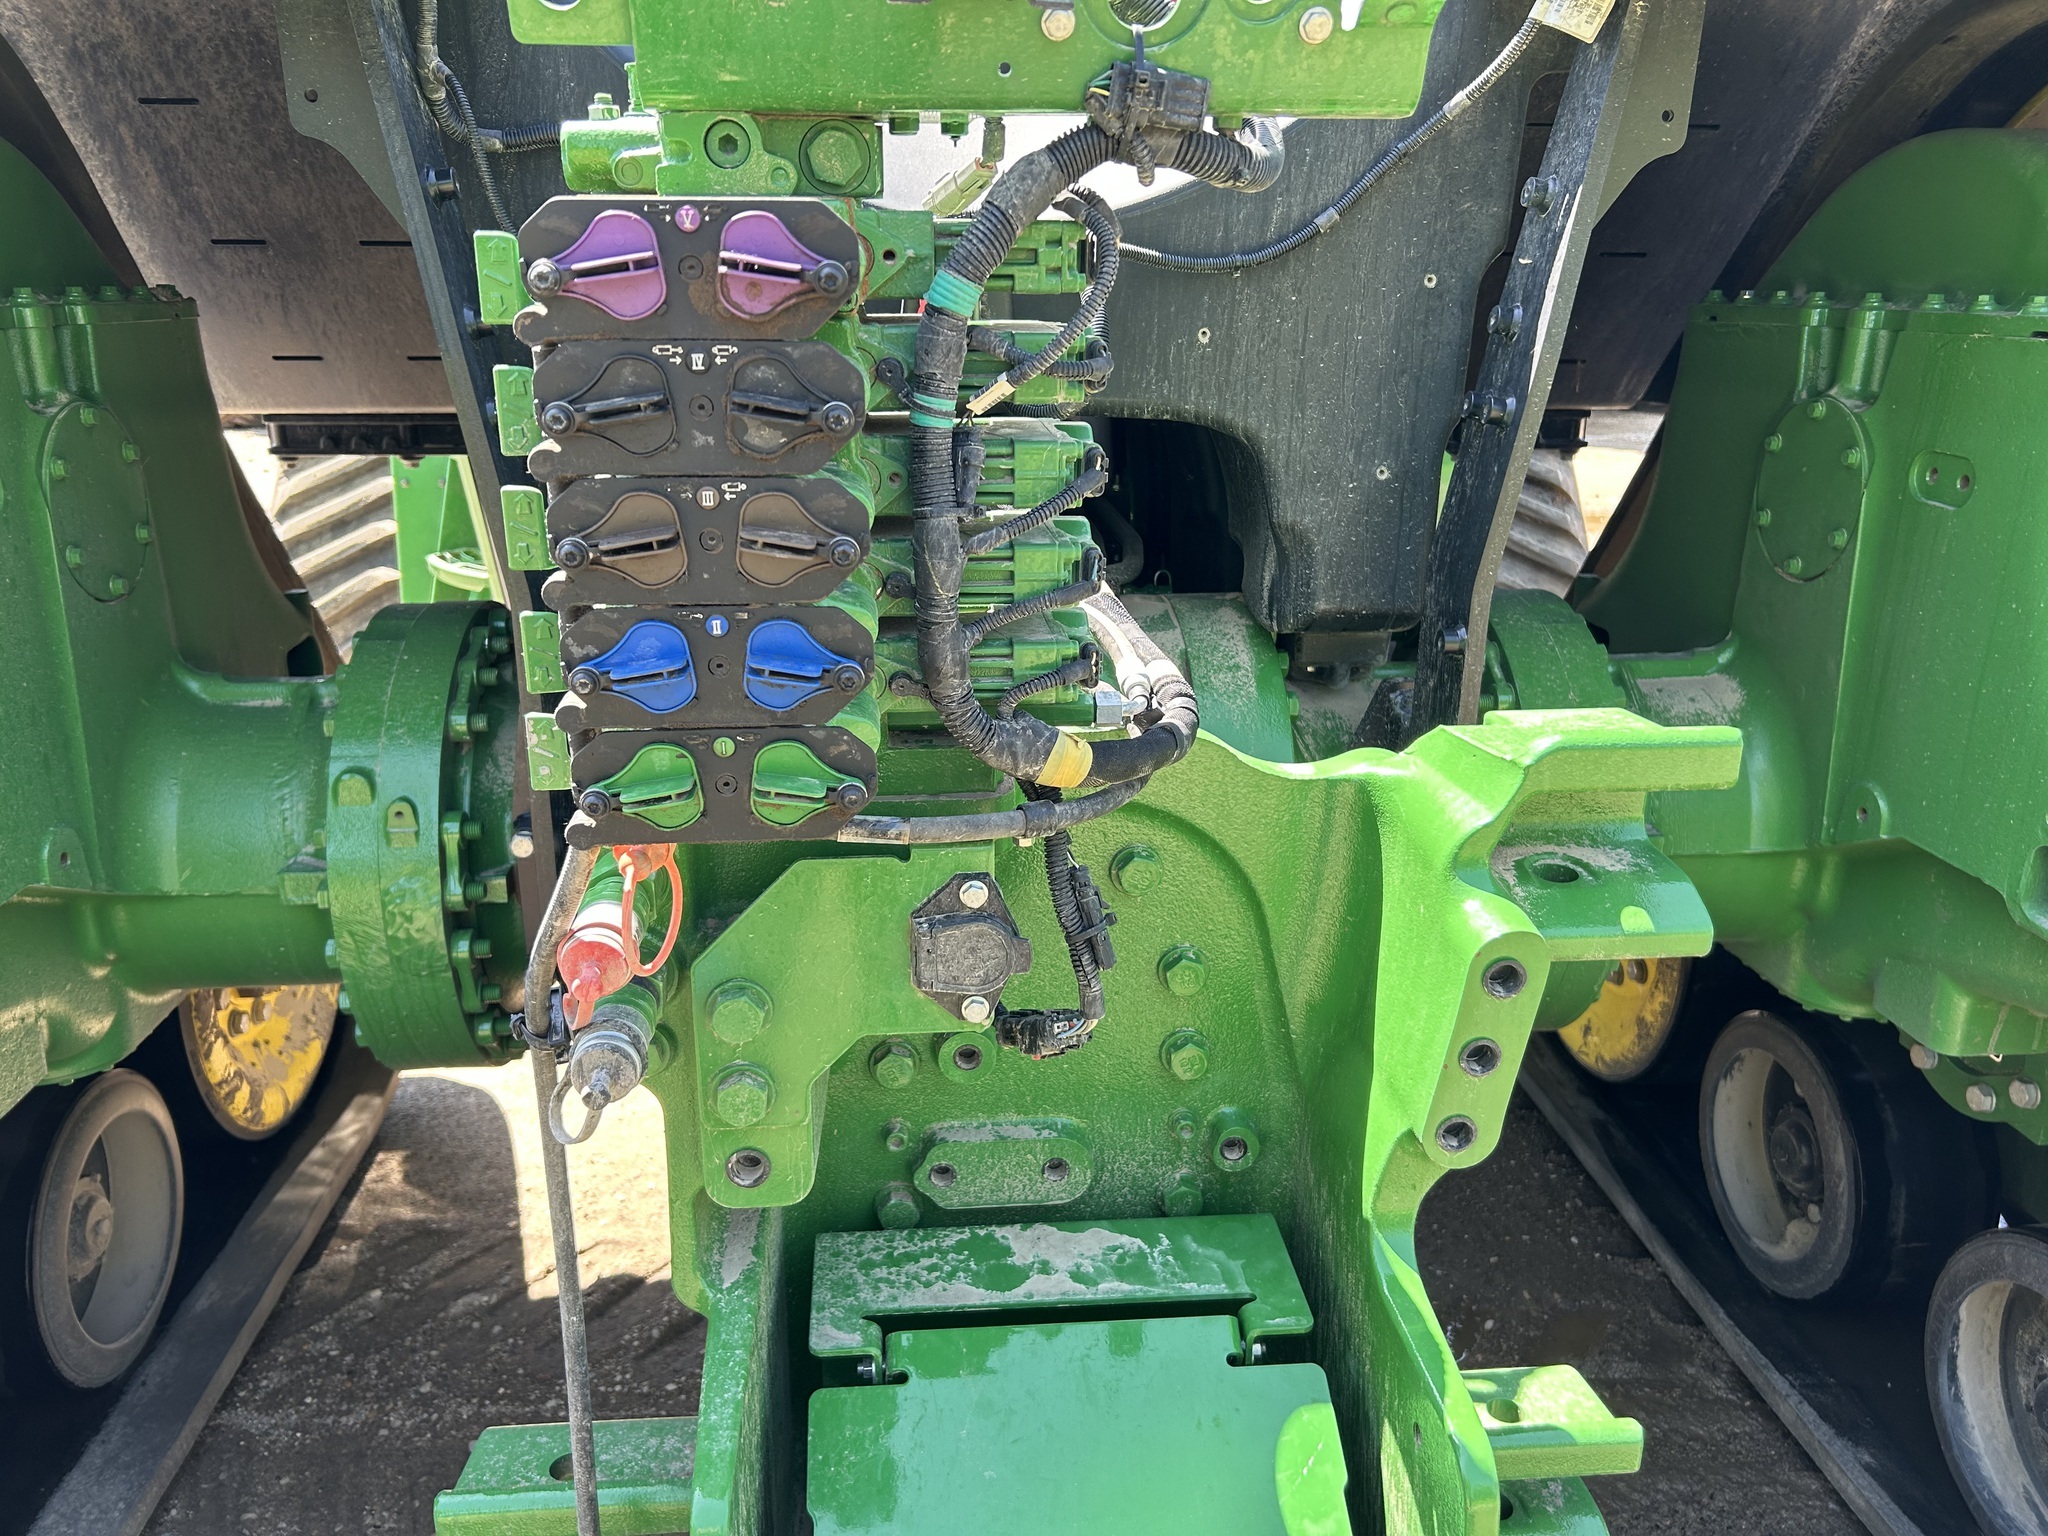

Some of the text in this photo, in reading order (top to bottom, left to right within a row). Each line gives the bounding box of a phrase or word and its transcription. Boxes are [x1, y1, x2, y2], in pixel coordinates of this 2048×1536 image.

[680, 209, 694, 228] V
[690, 353, 705, 370] IV
[702, 490, 714, 506] III
[711, 619, 722, 635] II
